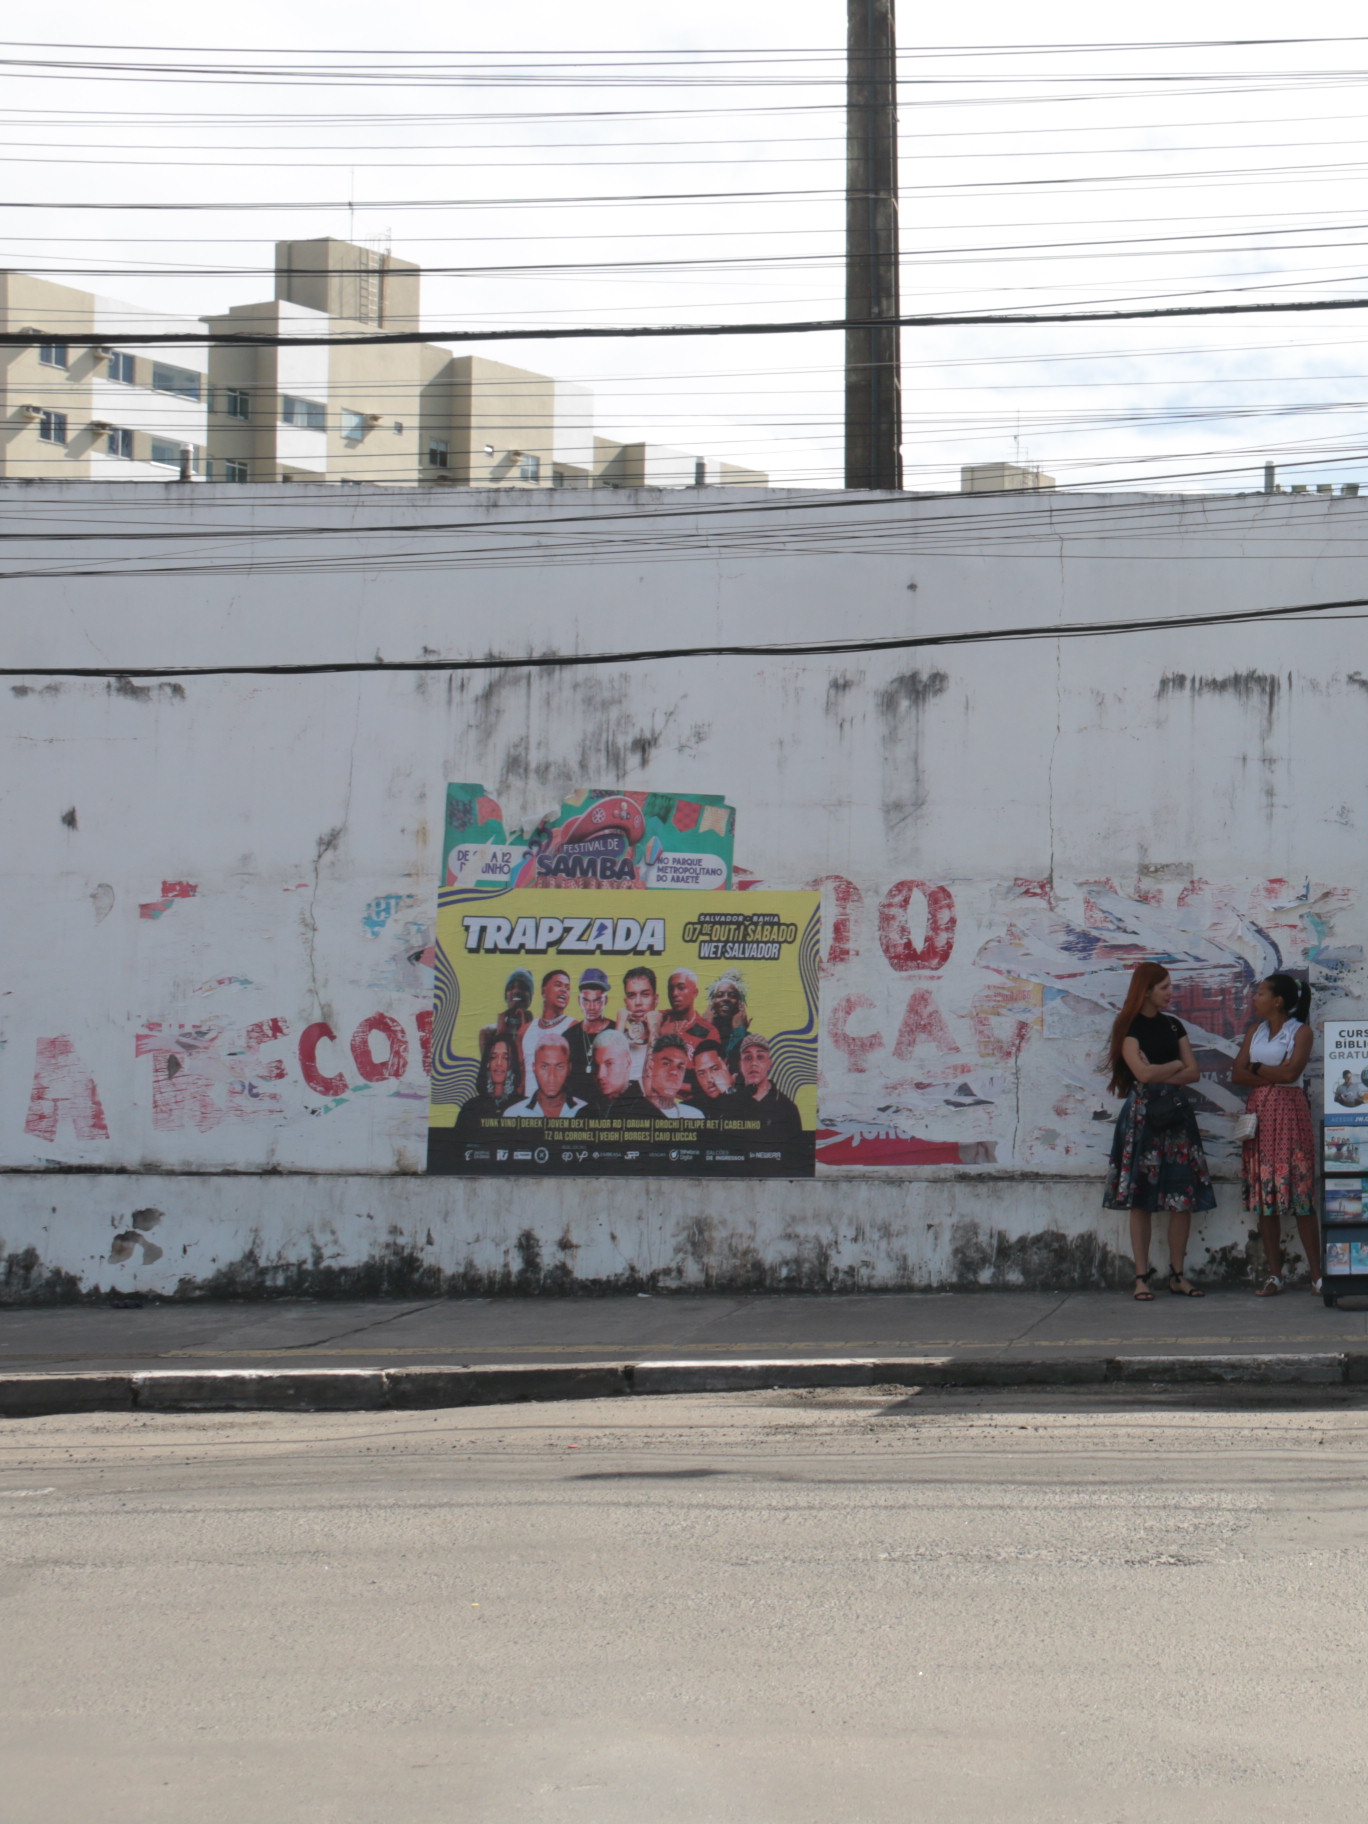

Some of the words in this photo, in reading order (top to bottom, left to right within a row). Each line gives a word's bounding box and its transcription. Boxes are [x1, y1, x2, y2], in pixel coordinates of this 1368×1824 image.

[563, 840, 605, 853] FESTIVAL
[607, 838, 619, 850] DE
[457, 850, 470, 861] DE
[502, 852, 512, 863] 12
[658, 857, 669, 865] NO
[672, 858, 703, 866] PARQUE
[536, 853, 636, 881] SAMBA
[657, 866, 723, 876] METROPOLITANO
[670, 874, 700, 883] ABAETÉ
[463, 916, 665, 954] TRAPZADA
[684, 924, 702, 941] 07
[702, 924, 712, 934] DE
[746, 922, 796, 941] SÁBADO
[700, 943, 724, 958] WET
[724, 943, 780, 958] SALVADOR
[480, 1119, 499, 1128] YUNK
[521, 1119, 543, 1128] DEREK
[547, 1119, 569, 1128] JOVEM
[571, 1119, 584, 1128] DEX
[589, 1119, 611, 1128] MAJOR
[612, 1120, 622, 1128] RD
[655, 1120, 679, 1129] OROCHI
[684, 1120, 705, 1129] FILIPE
[707, 1120, 719, 1129] RET
[724, 1120, 761, 1130] CABELINHO
[544, 1131, 552, 1140] TZ
[554, 1131, 563, 1140] DA
[564, 1131, 595, 1140] CORONEL
[599, 1131, 619, 1141] VEIGH
[624, 1132, 650, 1141] BORGES
[654, 1132, 671, 1141] CAIO
[672, 1132, 697, 1141] LUCCAS
